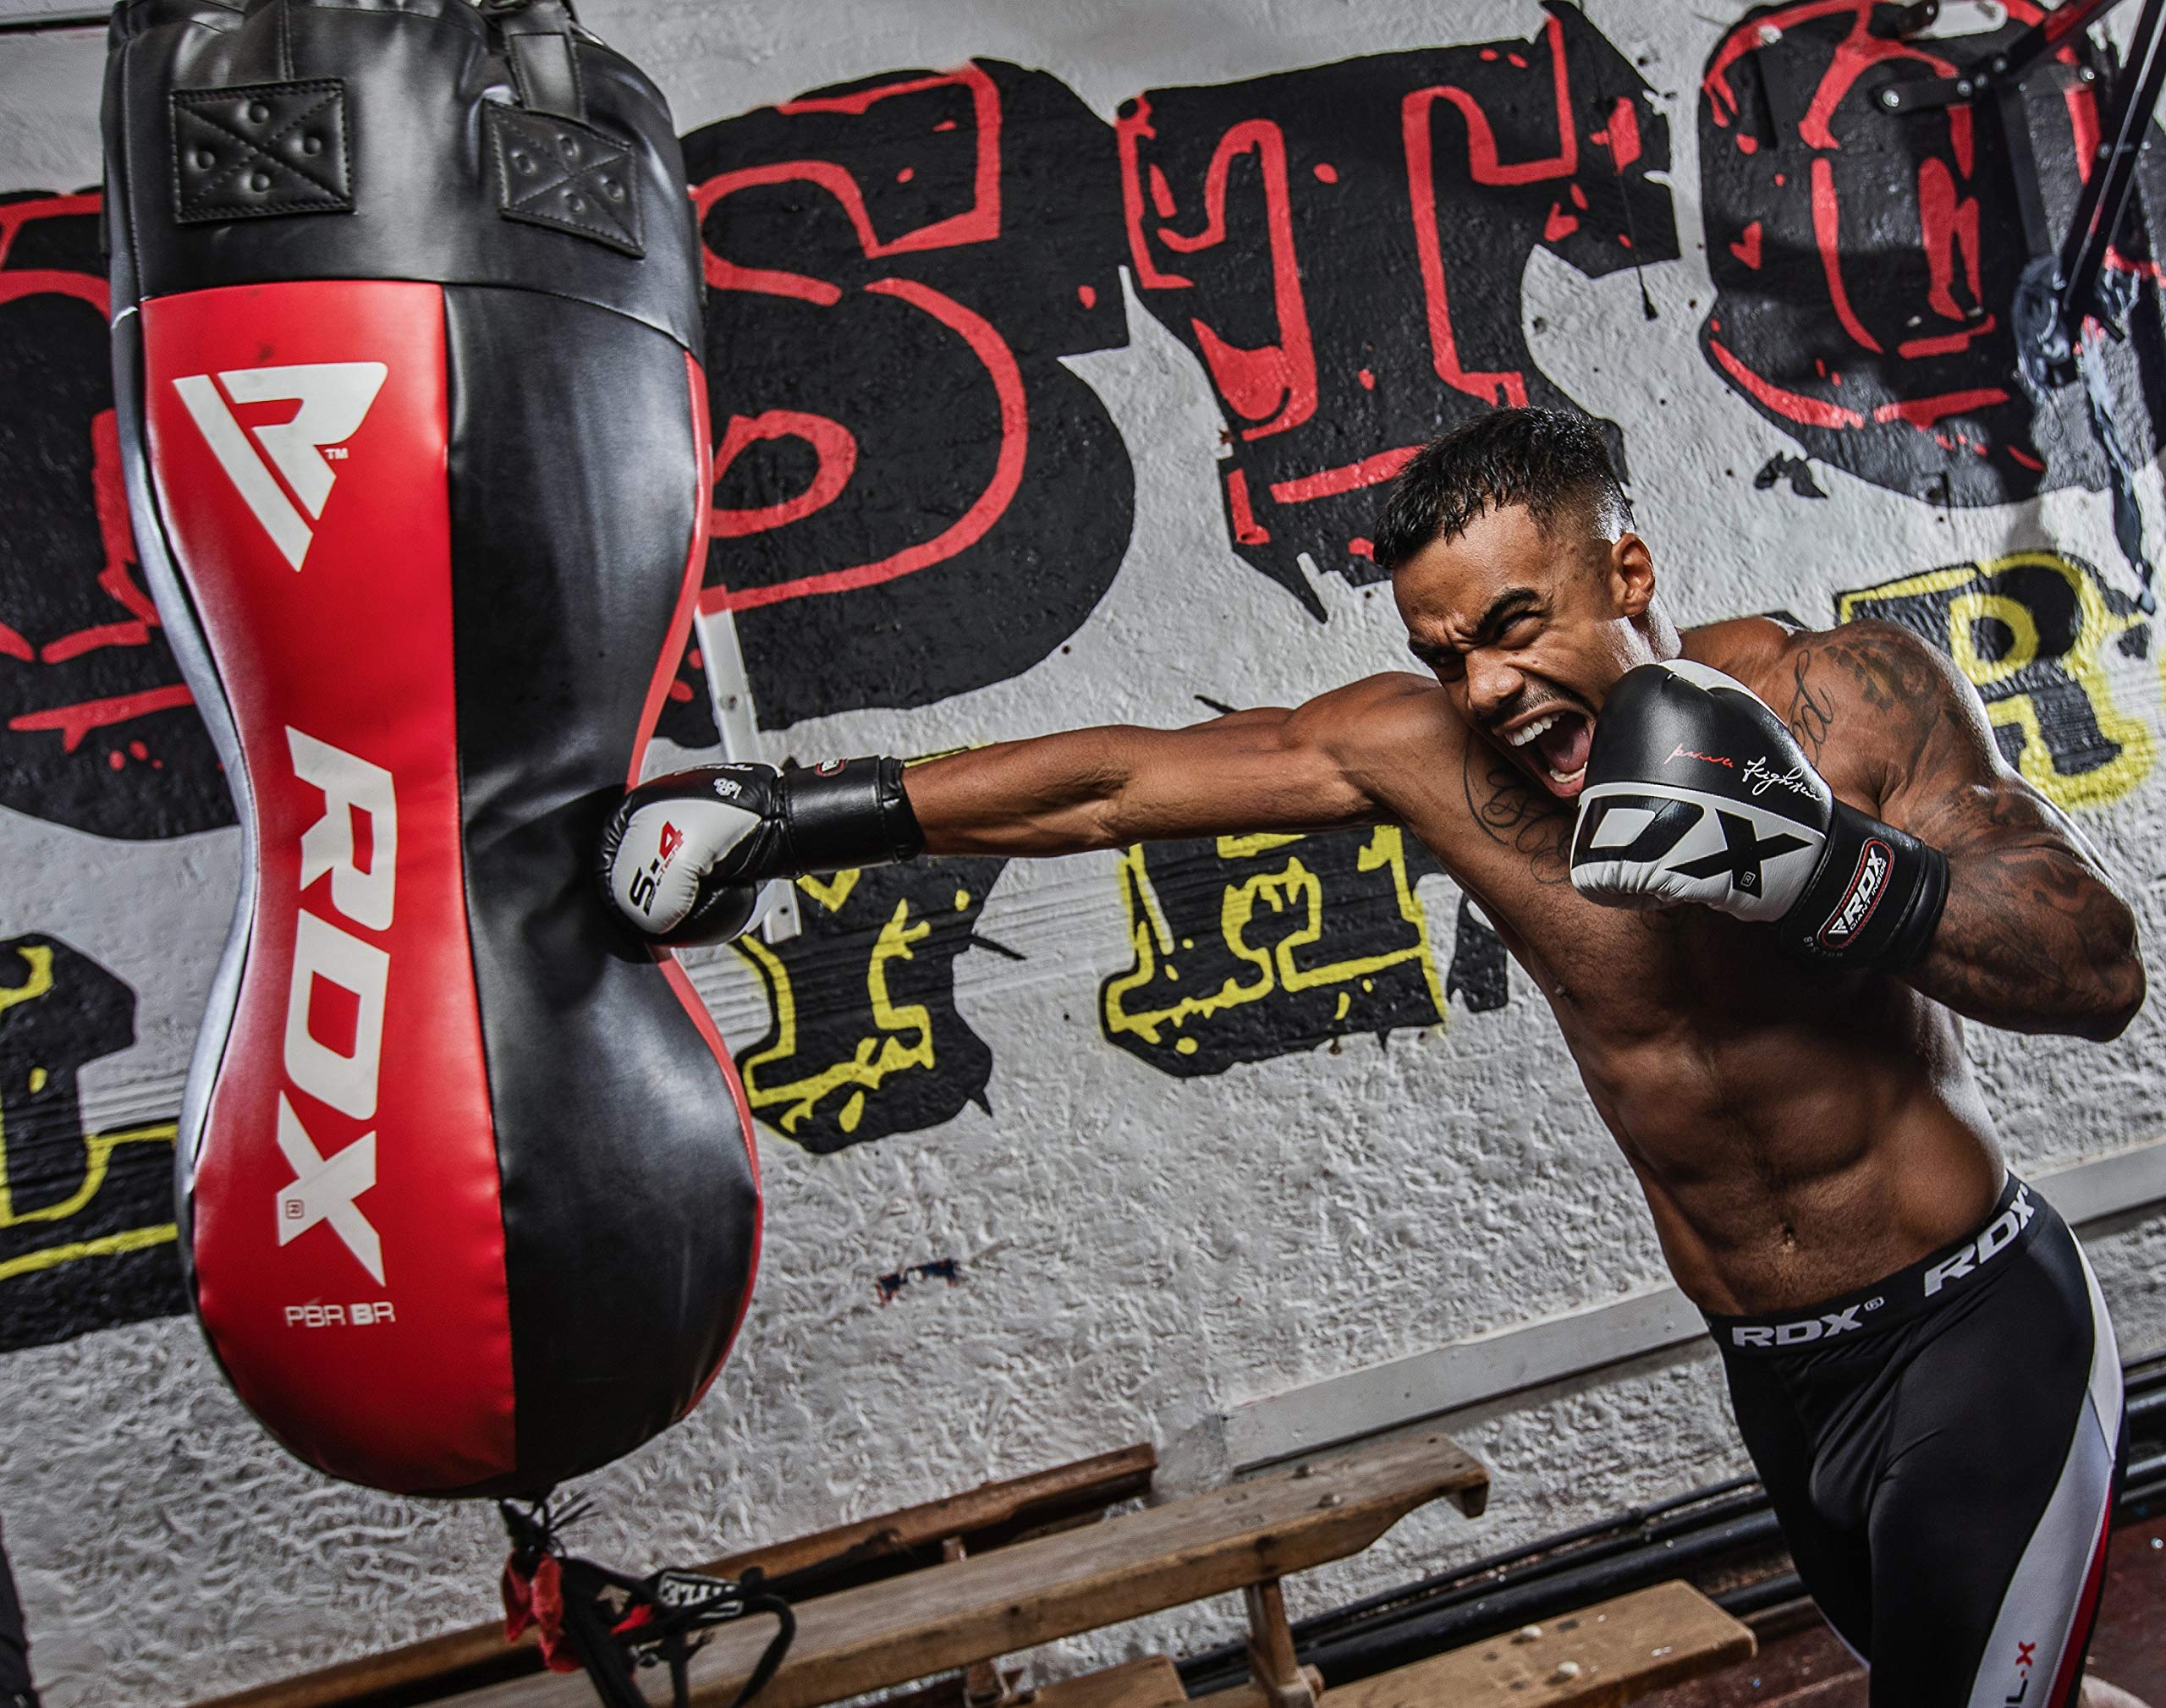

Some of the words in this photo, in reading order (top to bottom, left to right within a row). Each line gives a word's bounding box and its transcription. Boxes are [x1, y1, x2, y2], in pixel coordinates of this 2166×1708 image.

[1872, 860, 1887, 897] INSIDE
[285, 1304, 347, 1328] PBR
[349, 1301, 397, 1326] BR
